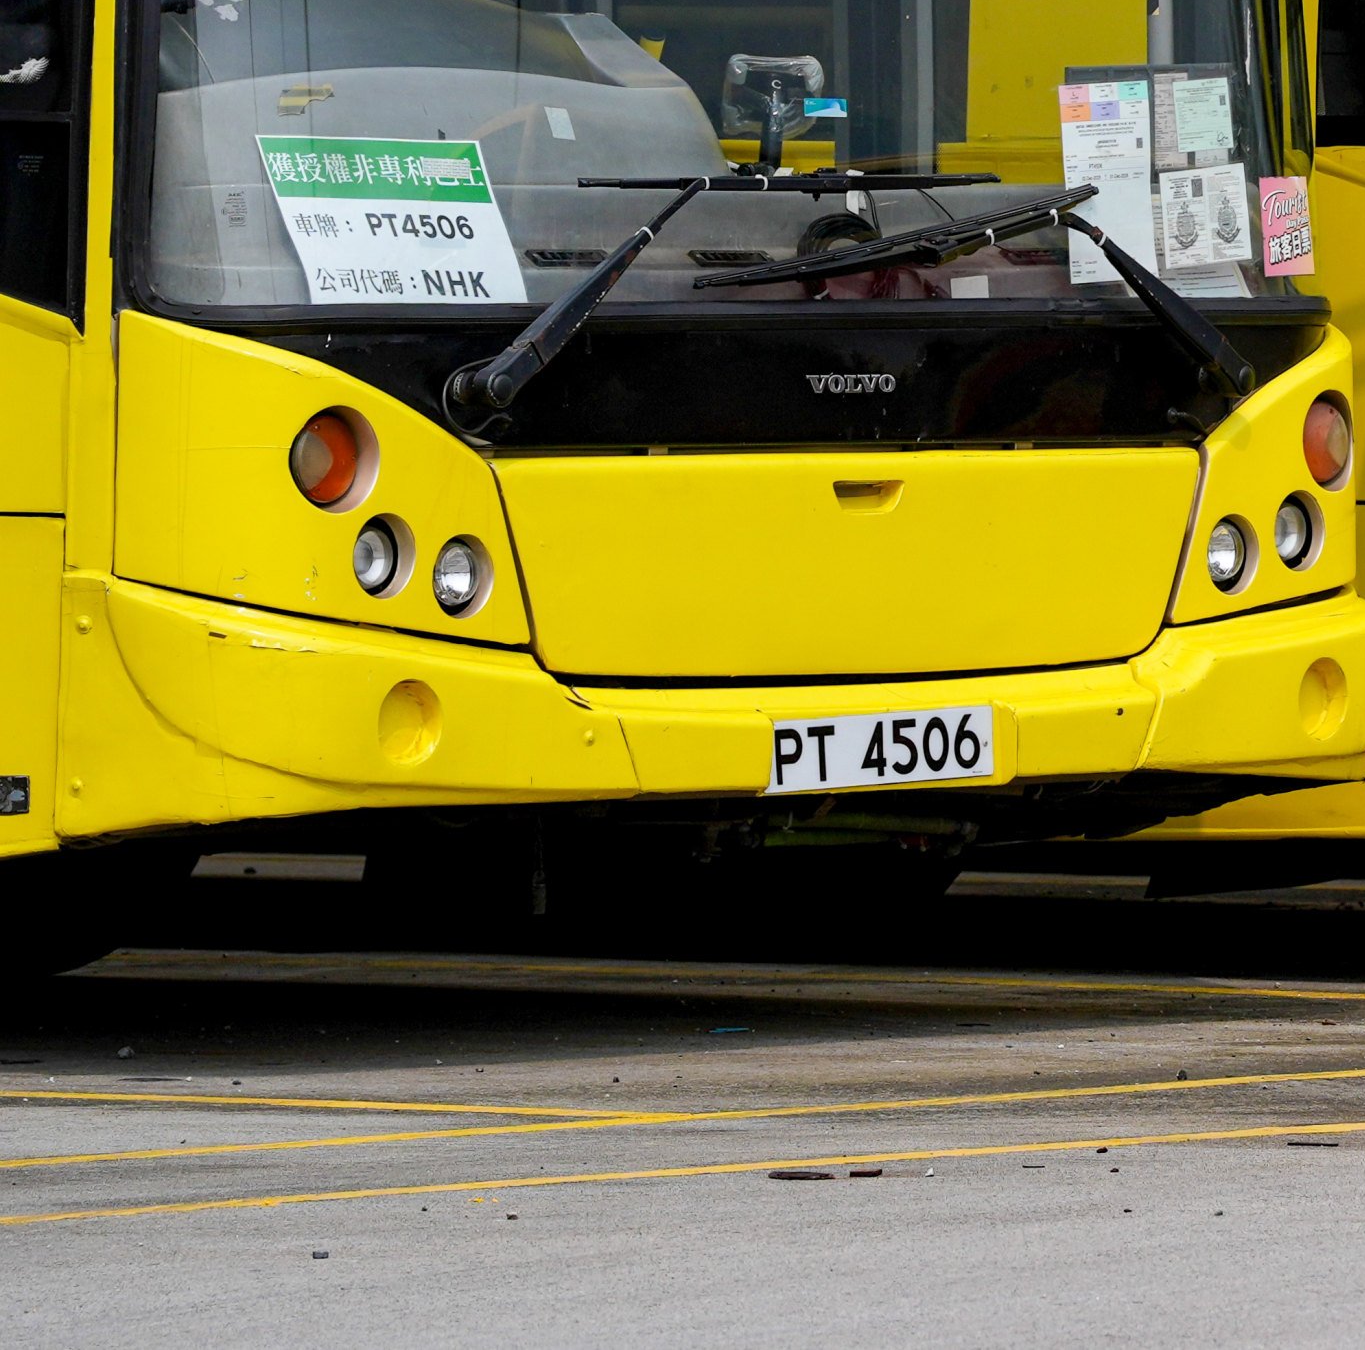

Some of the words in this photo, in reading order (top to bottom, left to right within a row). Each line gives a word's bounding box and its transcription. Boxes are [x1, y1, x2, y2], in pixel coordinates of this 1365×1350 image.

[1262, 190, 1307, 226] Tourist
[365, 212, 475, 240] PT4506
[805, 373, 897, 395] VOLVO
[774, 724, 836, 786] PT
[861, 713, 982, 778] 4506
